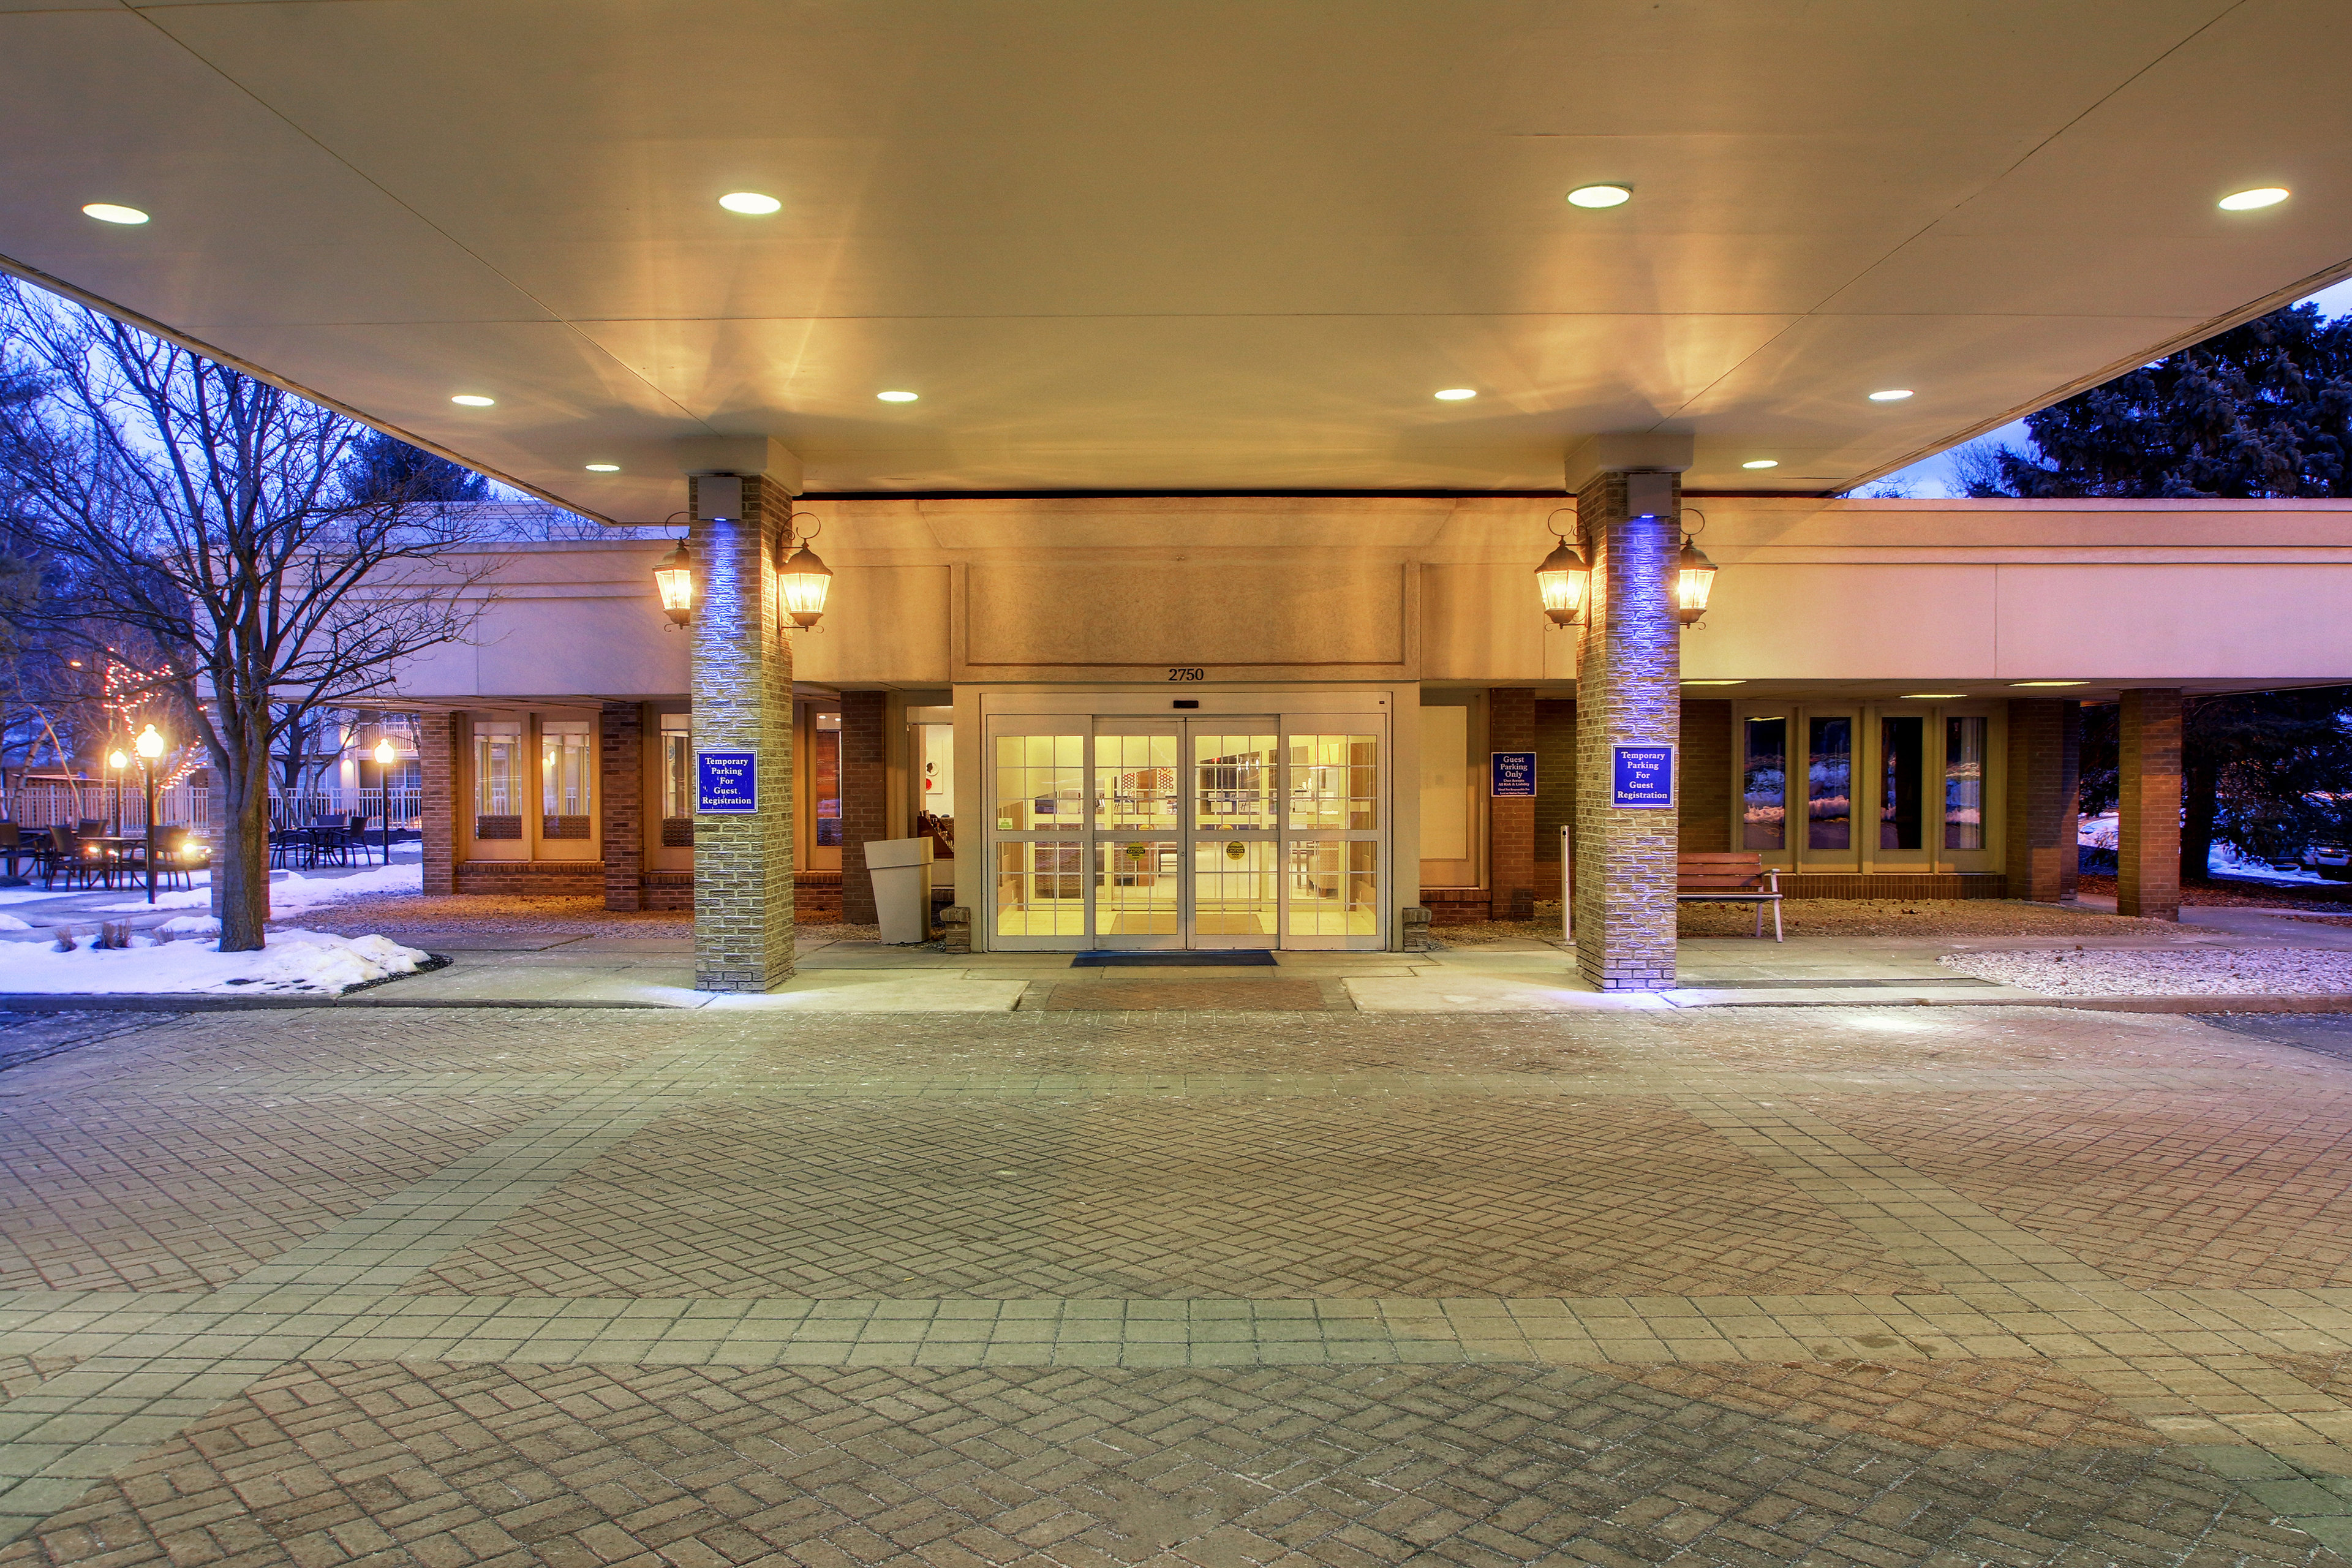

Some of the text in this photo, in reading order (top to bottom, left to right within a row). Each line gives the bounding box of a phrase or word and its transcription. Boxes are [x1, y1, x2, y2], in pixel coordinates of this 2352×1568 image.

[1169, 668, 1204, 681] 2750
[1621, 751, 1665, 760] Temporary
[704, 757, 748, 766] Temporary
[1627, 761, 1659, 770] Parking
[711, 767, 742, 776] Parking
[1617, 791, 1668, 800] Registration
[702, 796, 752, 805] Registration
